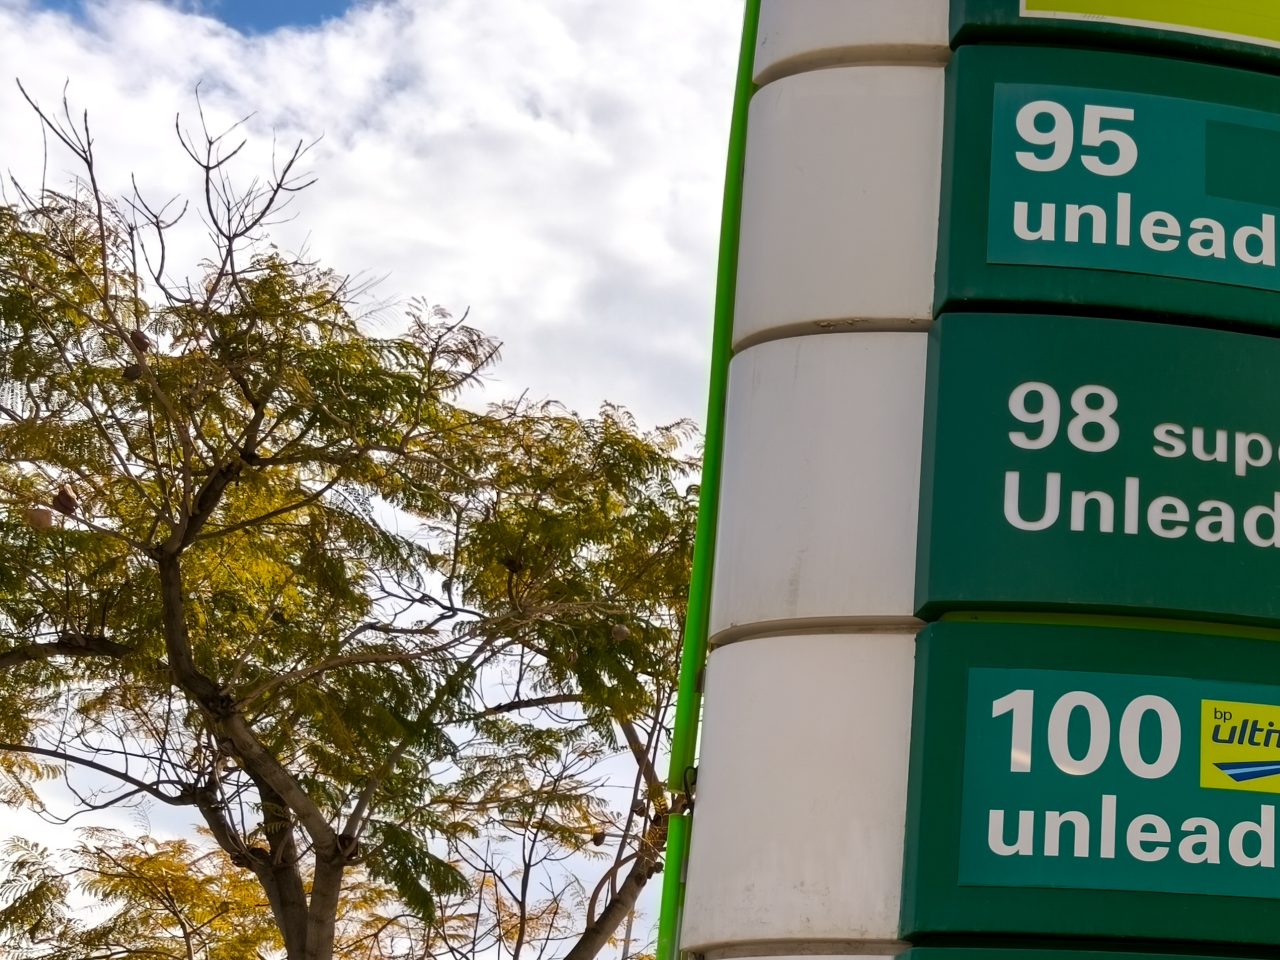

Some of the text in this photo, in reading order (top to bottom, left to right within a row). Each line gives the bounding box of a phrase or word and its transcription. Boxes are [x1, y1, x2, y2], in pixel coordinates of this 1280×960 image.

[1015, 99, 1138, 177] 95
[1008, 381, 1121, 453] 98
[991, 688, 1182, 780] 100
[1213, 706, 1233, 724] bp
